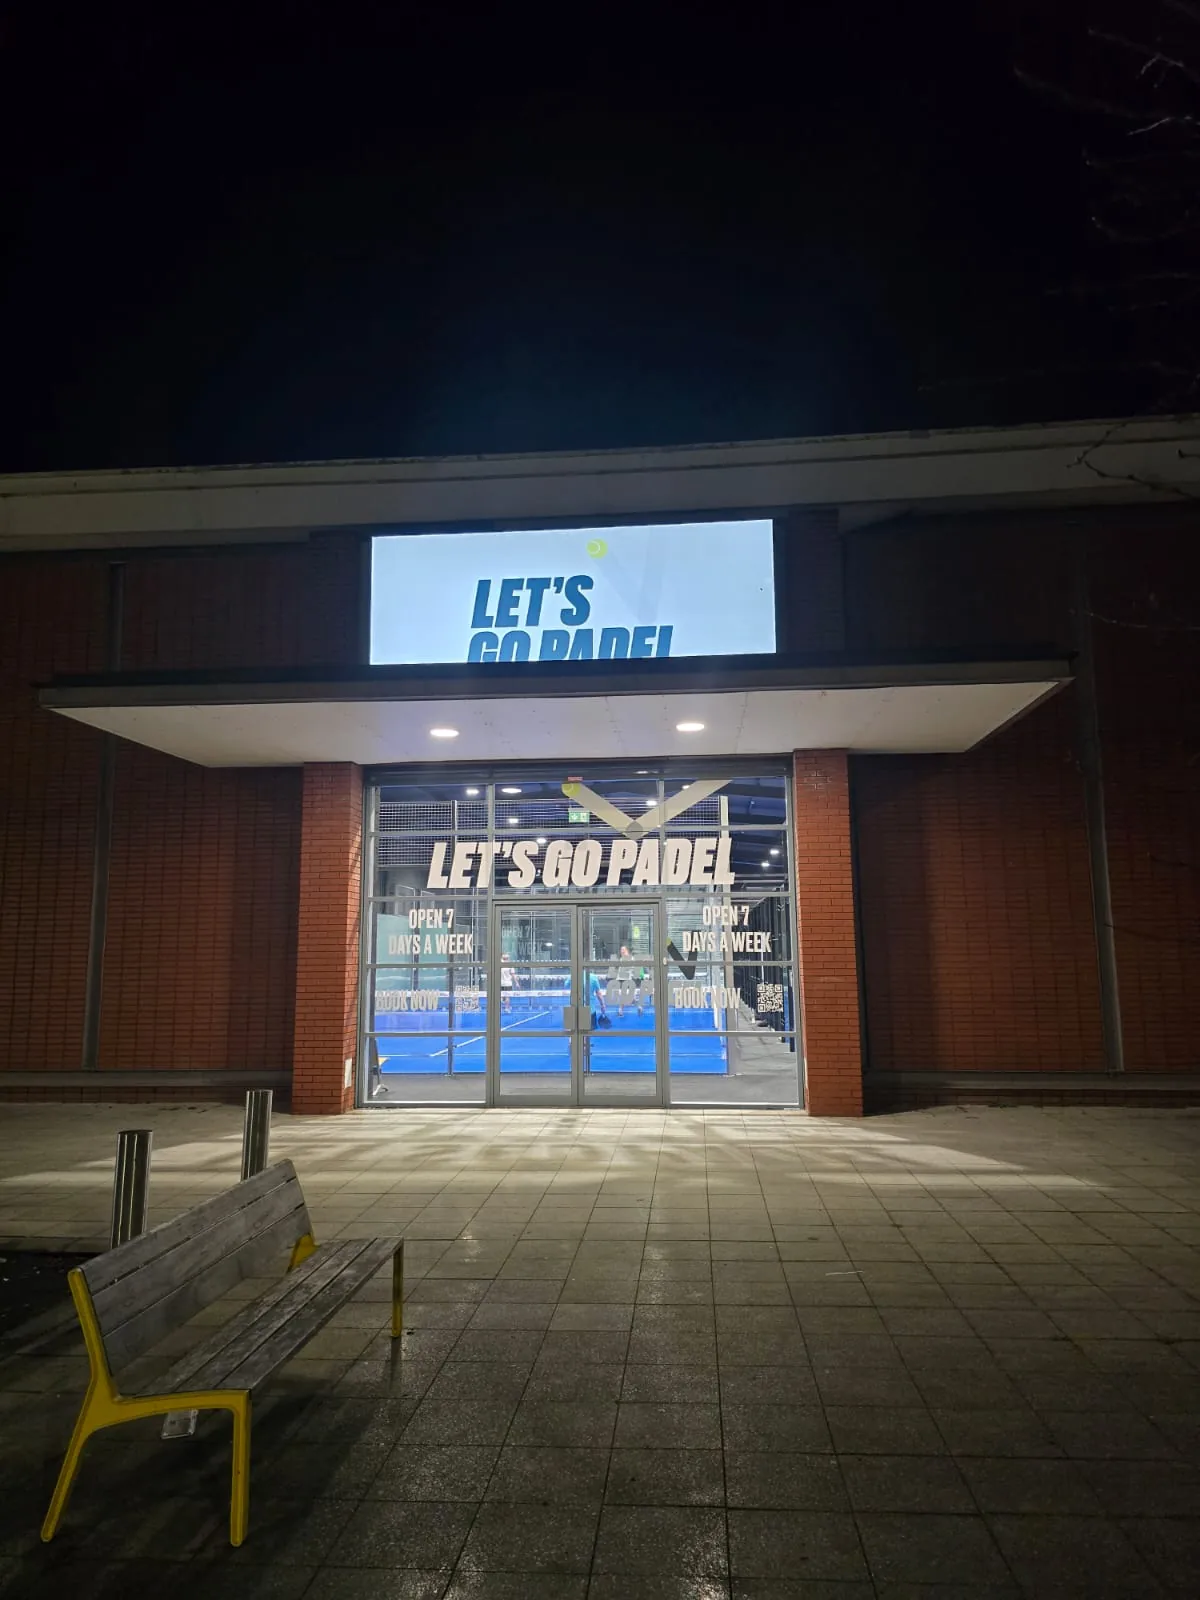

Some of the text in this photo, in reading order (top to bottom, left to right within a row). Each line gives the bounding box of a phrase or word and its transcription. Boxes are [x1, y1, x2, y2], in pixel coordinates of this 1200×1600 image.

[471, 575, 594, 628] LET'S
[427, 837, 735, 889] LET'S GO PADEL
[409, 908, 455, 929] OPEN 7
[702, 904, 750, 926] OPEN 7
[388, 933, 473, 955] DAYS A WEEK
[682, 931, 772, 953] DAYS A WEEK
[375, 989, 439, 1011] BOOK NOW
[674, 987, 709, 1009] BOOK
[711, 987, 741, 1009] NOW
